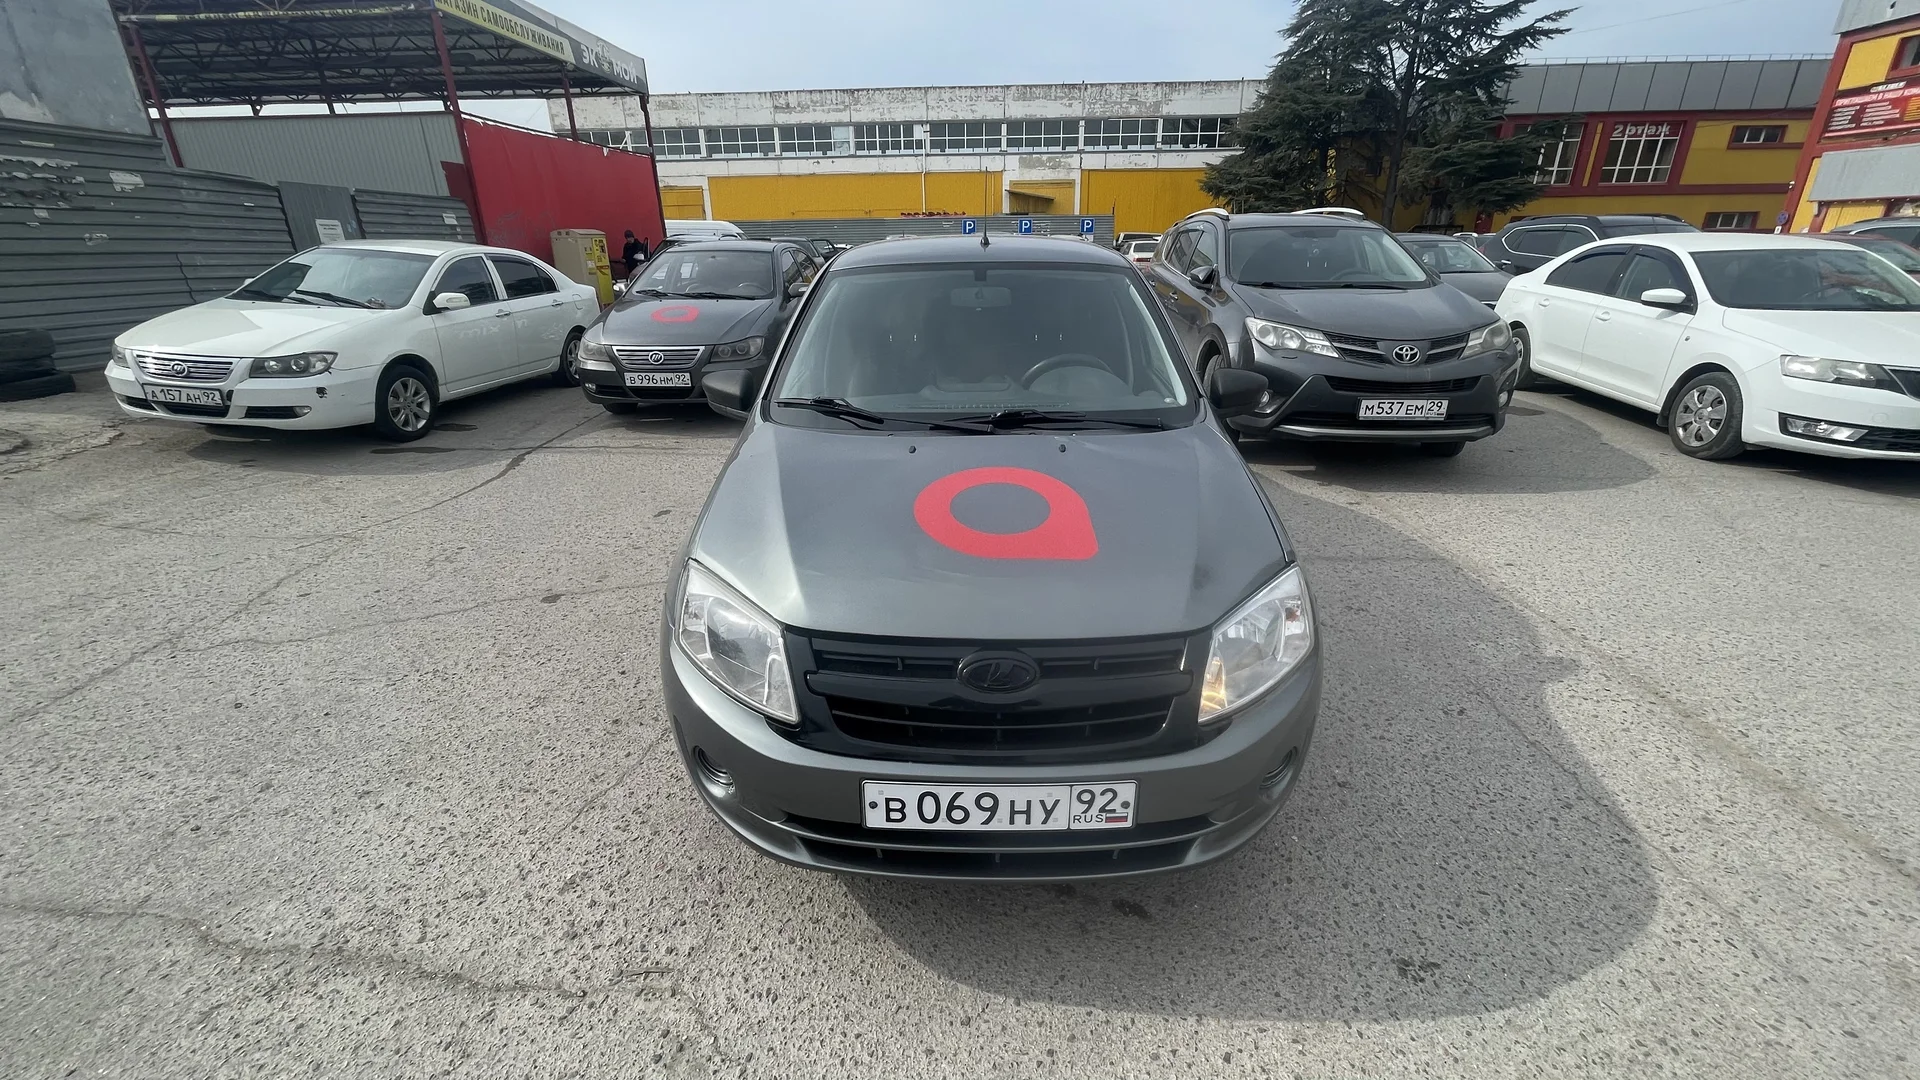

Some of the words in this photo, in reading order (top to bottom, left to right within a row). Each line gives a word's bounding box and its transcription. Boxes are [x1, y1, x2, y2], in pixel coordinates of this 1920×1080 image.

[480, 6, 565, 56] САМООБСЛУЖИВАНИЯ
[675, 374, 686, 382] 92
[203, 391, 217, 401] 92
[1428, 401, 1443, 411] 29
[1076, 787, 1118, 815] 92
[1072, 813, 1104, 824] RUS
